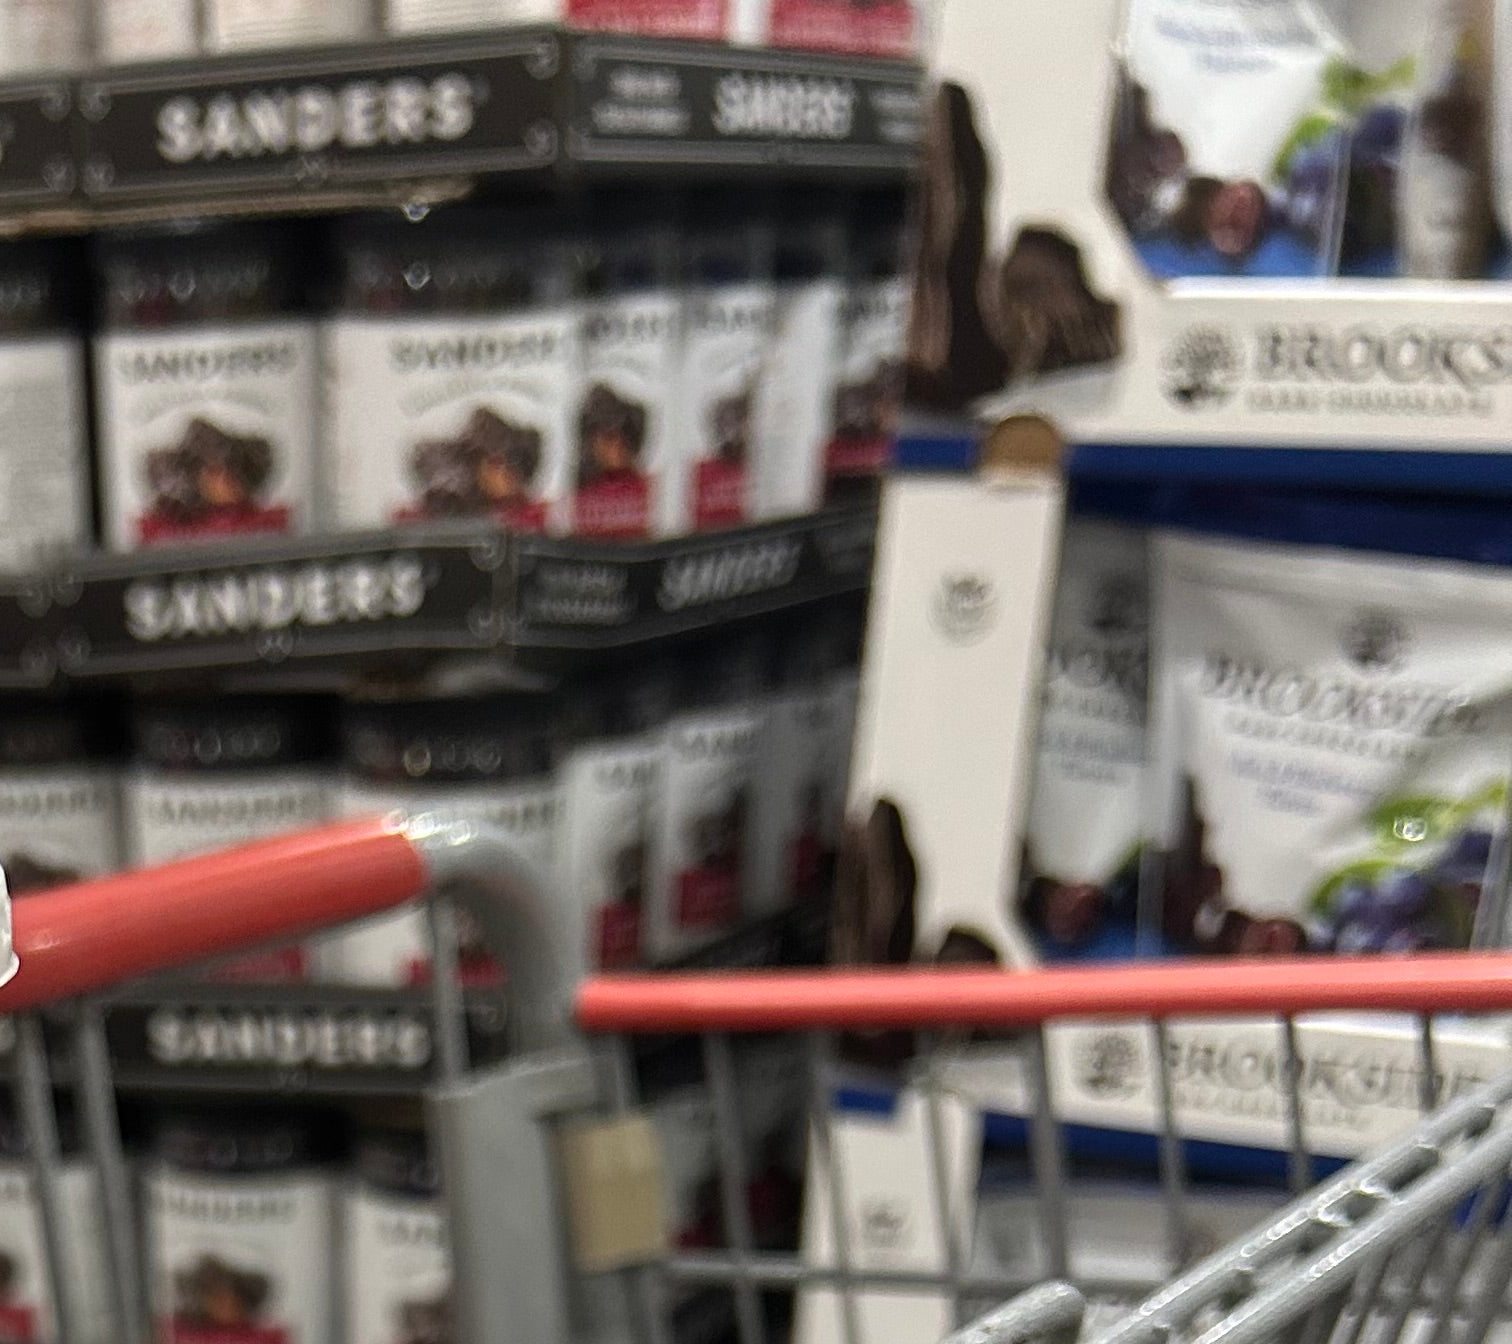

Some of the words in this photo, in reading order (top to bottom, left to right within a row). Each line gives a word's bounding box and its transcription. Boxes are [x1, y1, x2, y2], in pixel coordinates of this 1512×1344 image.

[158, 75, 476, 162] SANDERS
[125, 560, 423, 642] SANDERS
[148, 1013, 432, 1066] SANDERS
